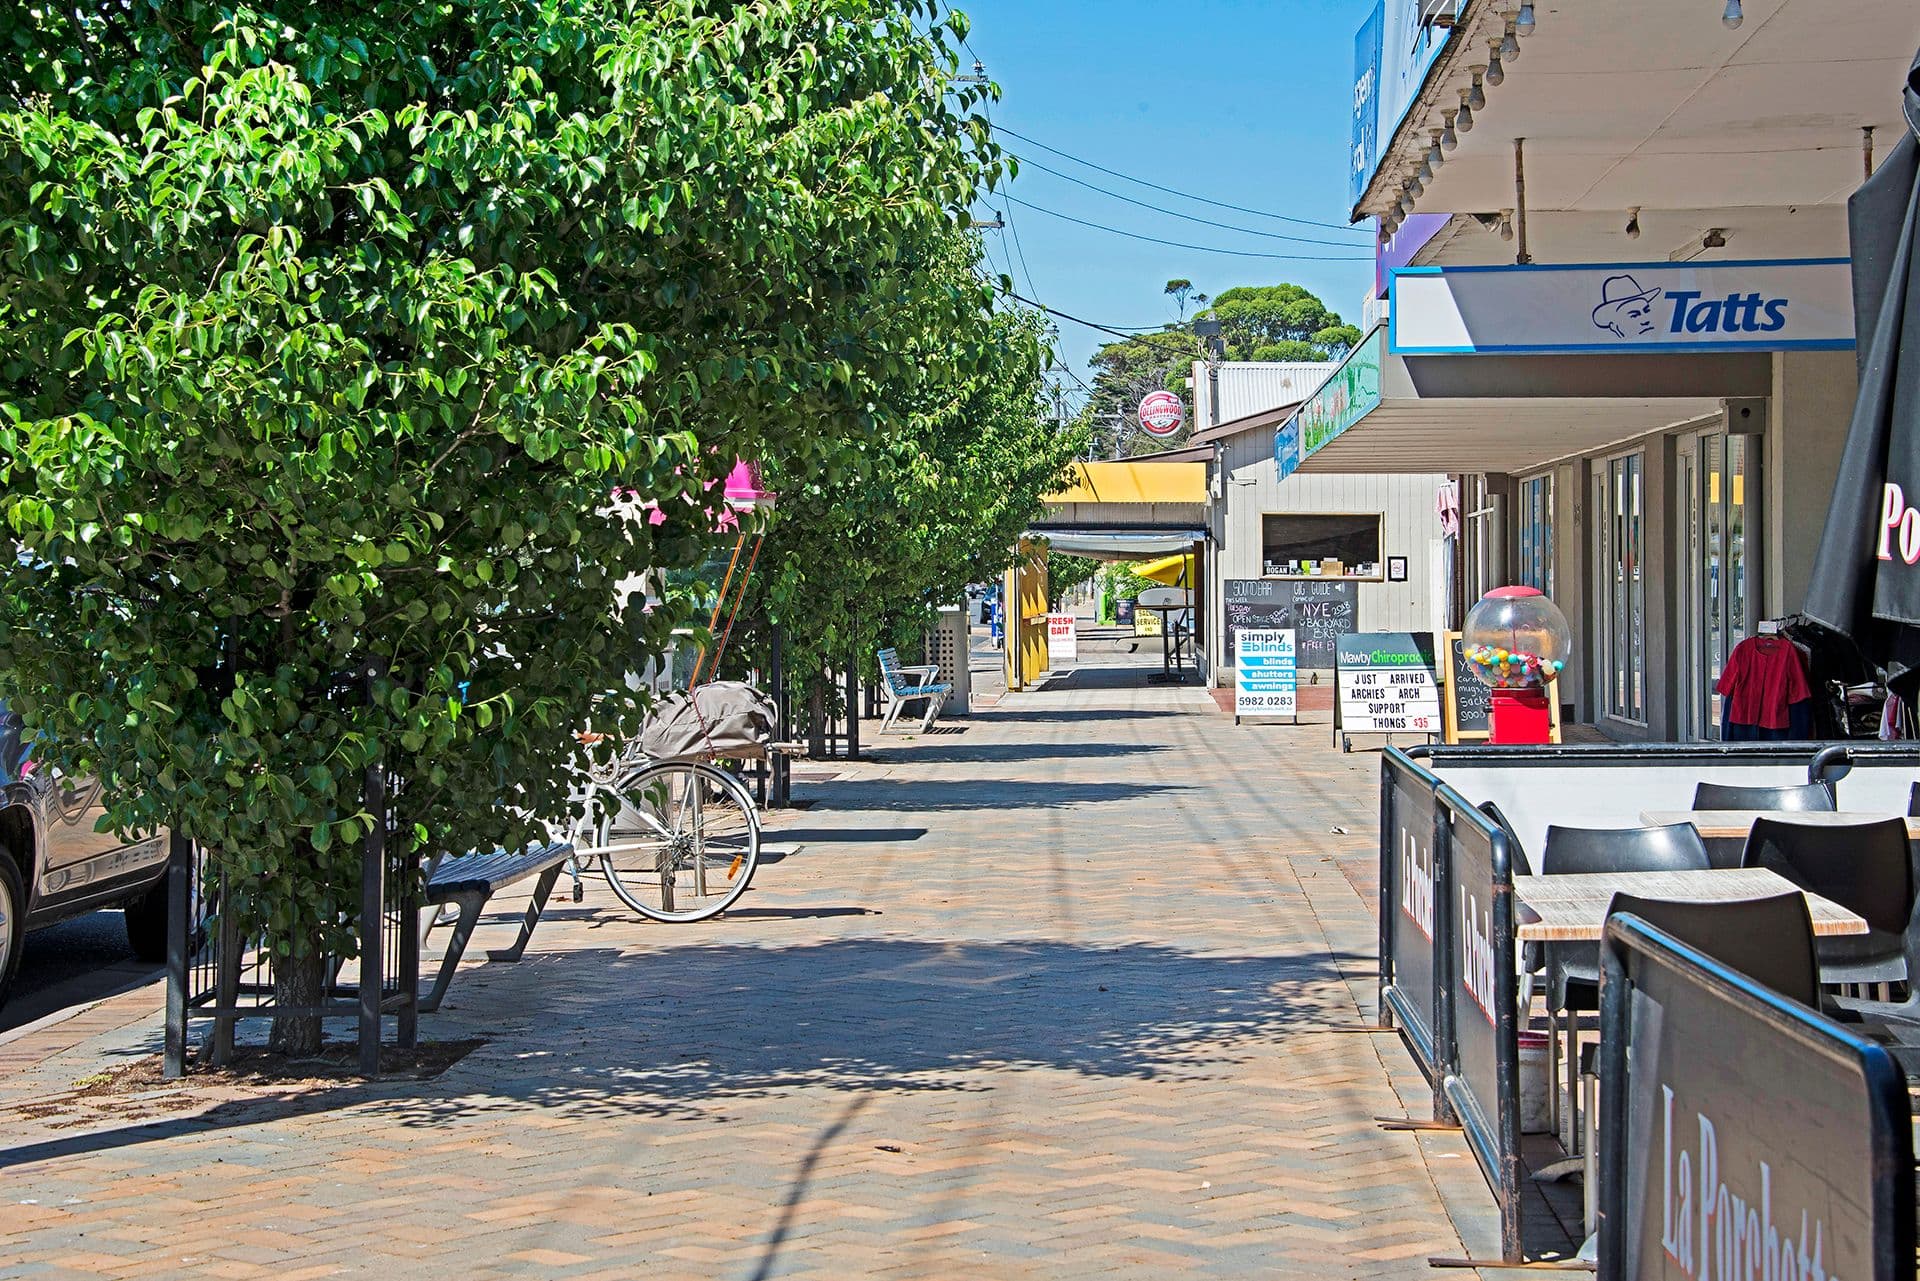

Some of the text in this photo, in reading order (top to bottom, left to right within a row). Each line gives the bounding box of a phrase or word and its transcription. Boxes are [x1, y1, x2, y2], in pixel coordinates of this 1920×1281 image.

[1664, 291, 1788, 333] Tatts
[1303, 603, 1331, 617] NYE
[1046, 617, 1073, 625] FRESH
[1306, 618, 1351, 629] BACKYARD
[1051, 627, 1069, 635] BAIT
[1241, 632, 1285, 643] simply
[1252, 642, 1293, 652] blinds
[1263, 658, 1293, 666] blinds
[1251, 670, 1293, 679] shutters
[1355, 673, 1425, 684] JUST ARRIVED
[1251, 682, 1293, 691] awnings
[1351, 688, 1420, 700] ARCHIES ARCH
[1239, 697, 1293, 706] 5982 0283
[1369, 703, 1405, 714] SUPPORT
[1373, 718, 1429, 728] THONGS $35
[1662, 1084, 1695, 1276] La
